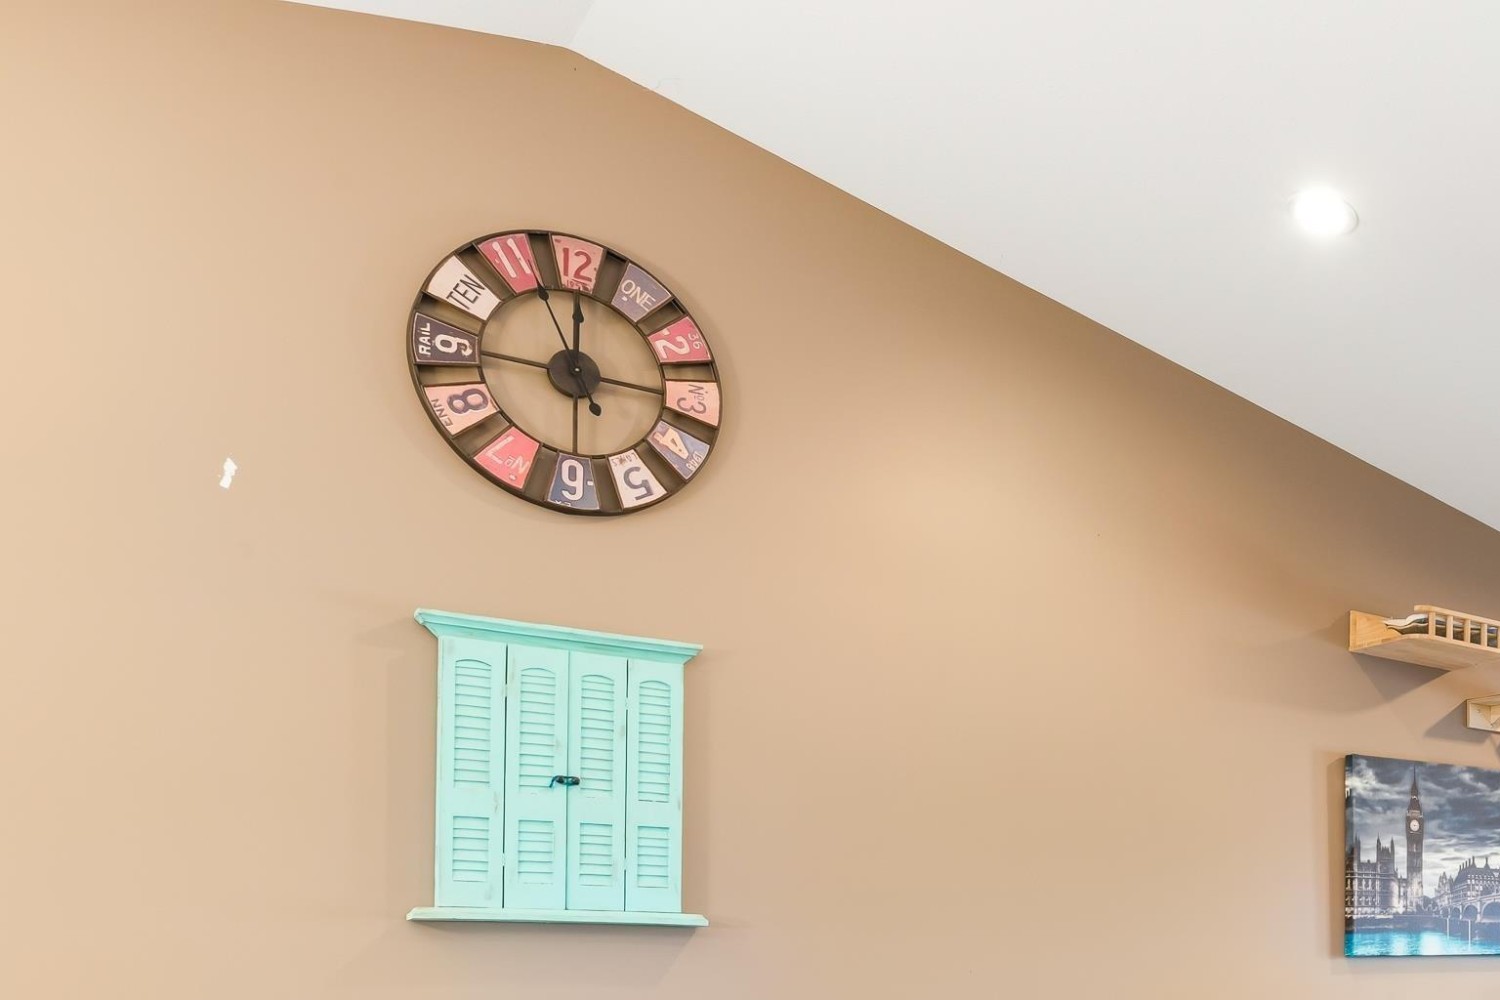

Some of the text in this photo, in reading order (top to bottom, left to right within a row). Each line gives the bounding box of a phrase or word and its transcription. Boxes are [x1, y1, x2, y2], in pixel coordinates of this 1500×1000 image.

[492, 238, 532, 279] 11
[562, 247, 592, 282] 12
[446, 274, 485, 309] TEN
[621, 279, 657, 312] ONE
[418, 322, 431, 355] RAIL
[434, 334, 473, 357] 9
[655, 335, 690, 359] 2
[687, 332, 702, 350] 36
[447, 388, 489, 414] 8
[652, 427, 689, 460] 4
[623, 466, 653, 501] 5
